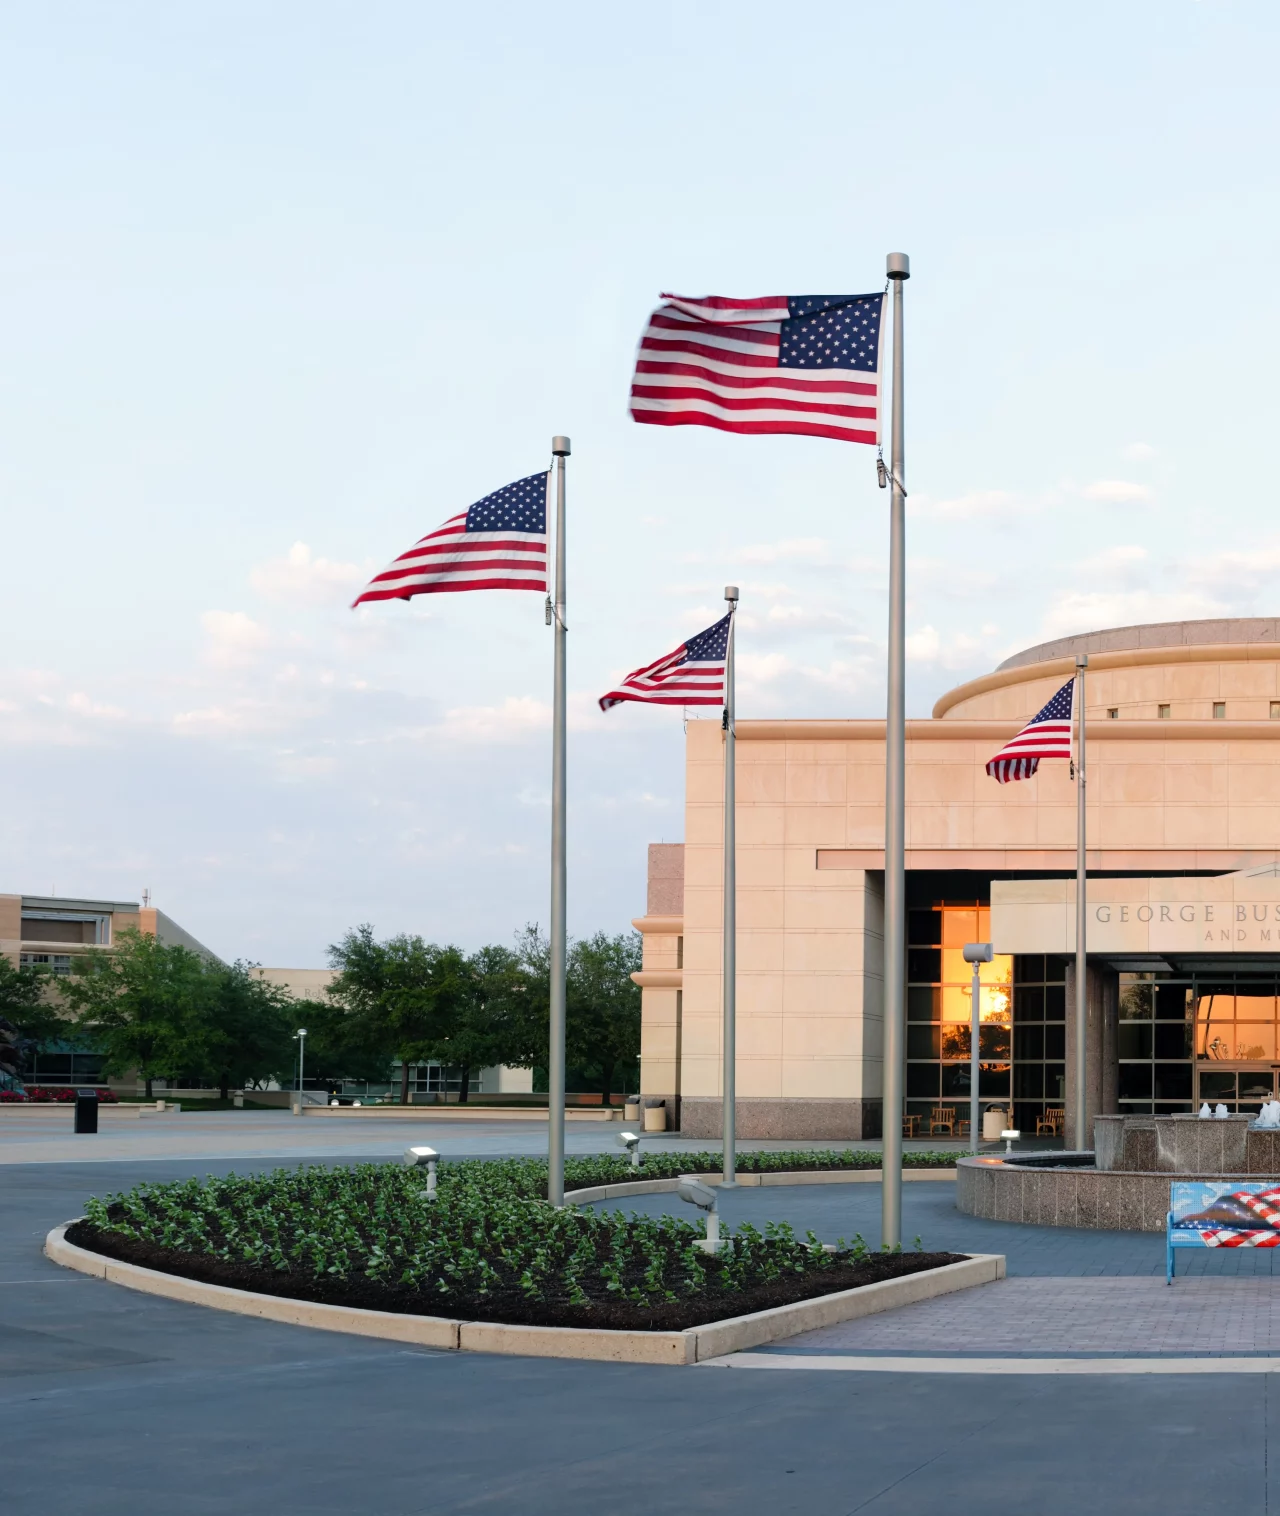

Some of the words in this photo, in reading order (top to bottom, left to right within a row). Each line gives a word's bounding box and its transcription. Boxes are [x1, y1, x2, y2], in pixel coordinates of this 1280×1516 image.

[1095, 905, 1215, 923] GEORGE
[1204, 929, 1247, 941] AND
[304, 988, 331, 998] Robe
